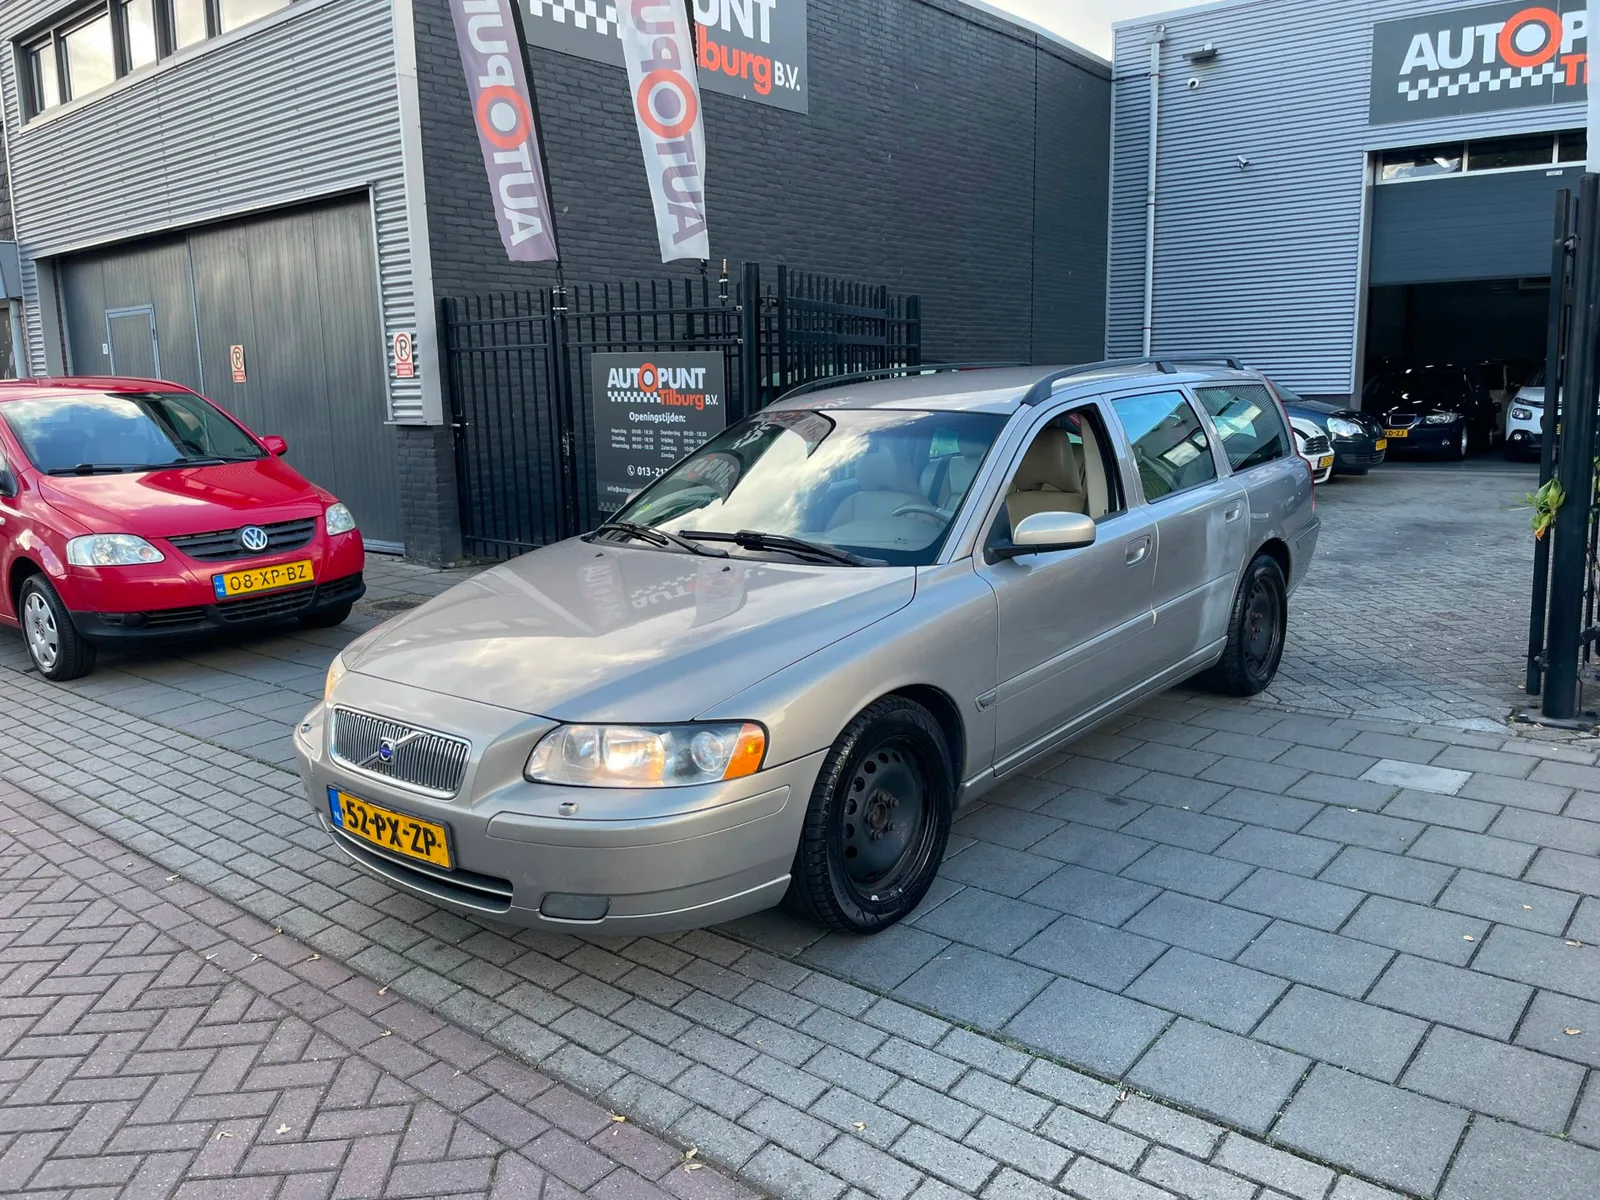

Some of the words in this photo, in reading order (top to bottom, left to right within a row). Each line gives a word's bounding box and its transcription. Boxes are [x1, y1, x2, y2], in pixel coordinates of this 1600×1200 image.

[774, 60, 801, 91] B.V.
[607, 362, 706, 393] AUTOPUNT
[659, 388, 705, 410] Tilburg
[705, 394, 718, 405] B.V.
[629, 411, 686, 424] Openingstijden:
[230, 564, 306, 591] 08-XP-BZ
[333, 809, 342, 821] NL
[345, 799, 437, 857] 52-PX-ZP
